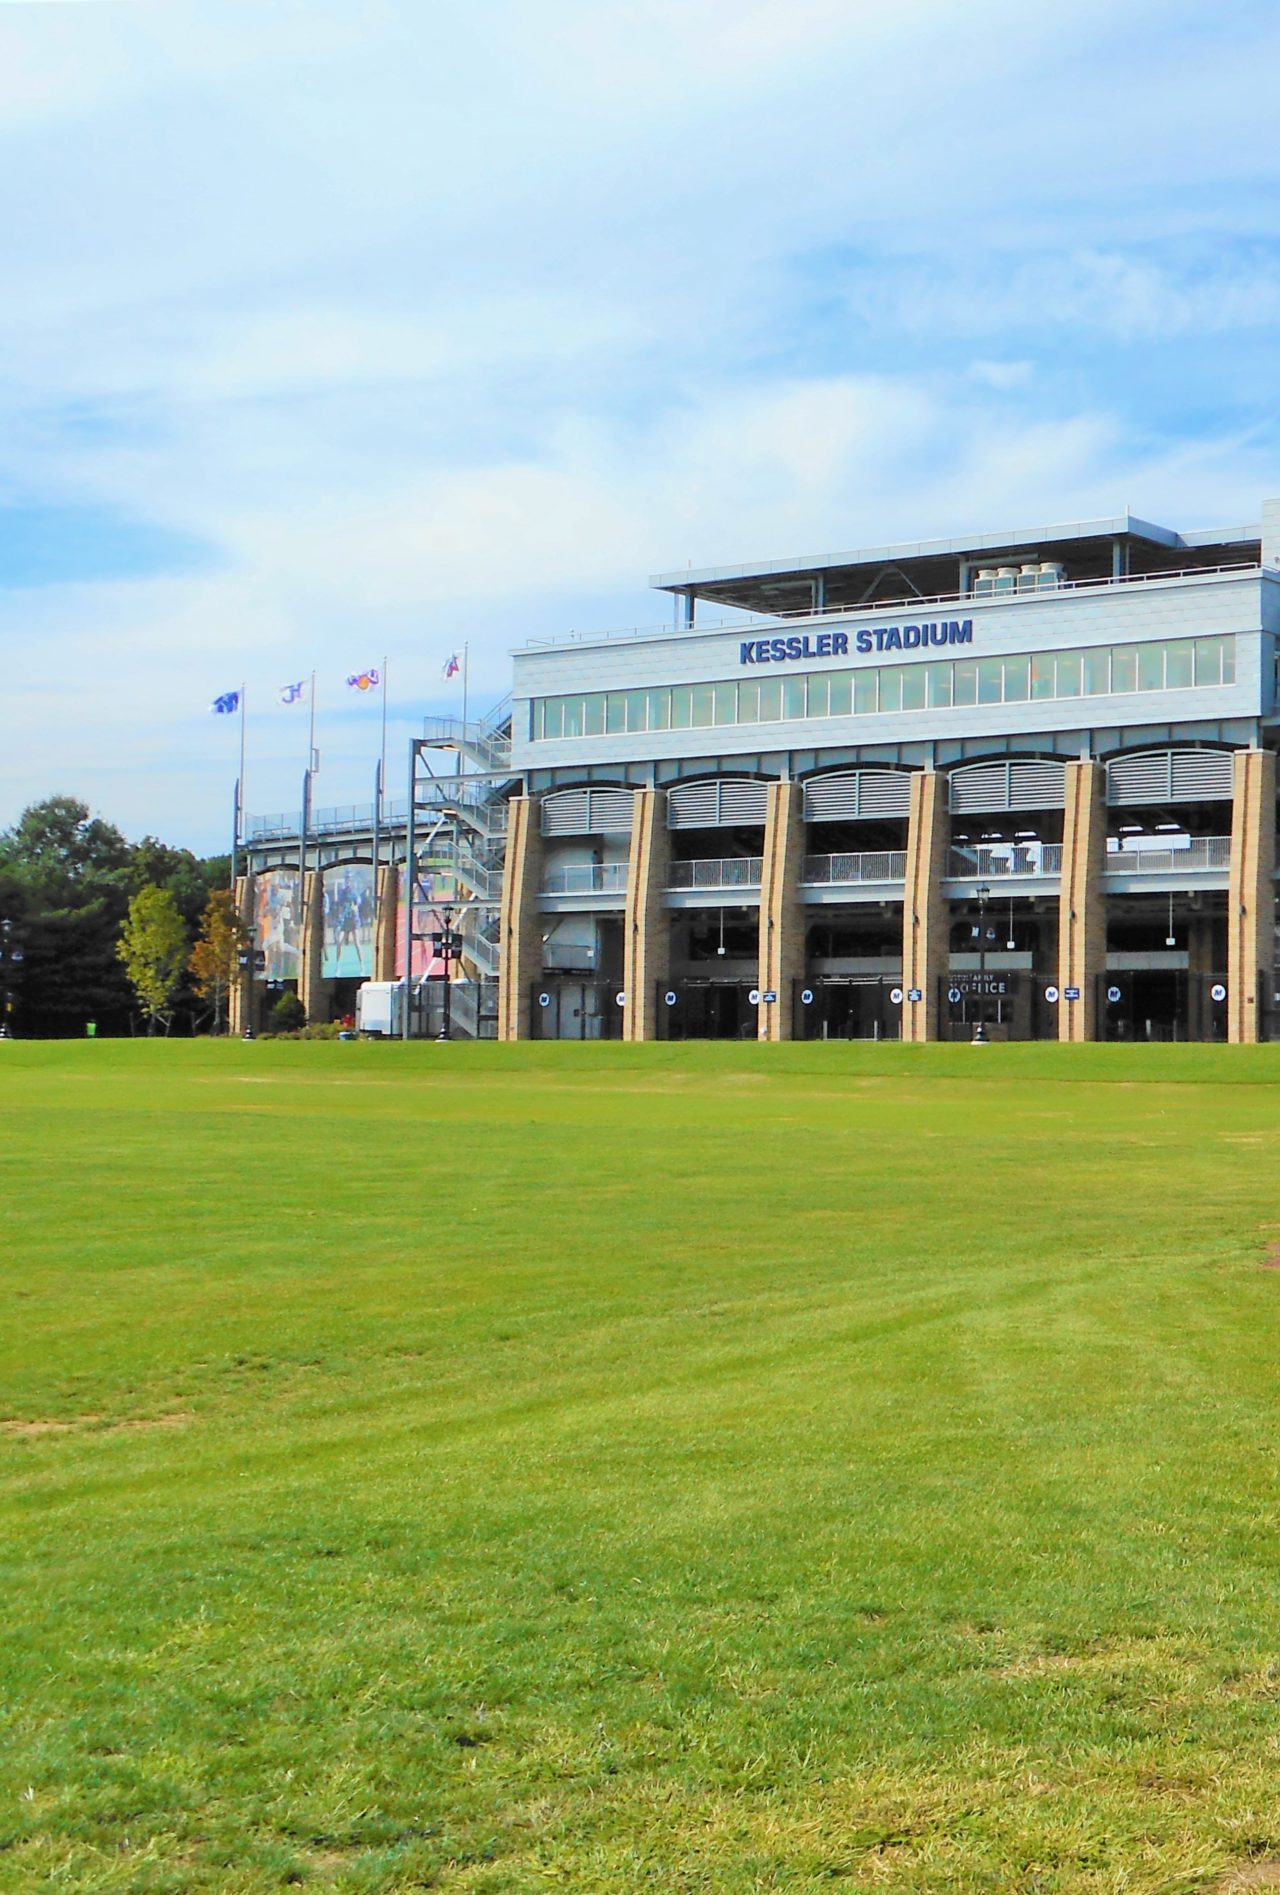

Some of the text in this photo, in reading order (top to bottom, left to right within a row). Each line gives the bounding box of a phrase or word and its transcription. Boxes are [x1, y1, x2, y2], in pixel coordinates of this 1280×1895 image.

[740, 619, 974, 665] KESSLER STADIUM
[1048, 990, 1056, 998] M
